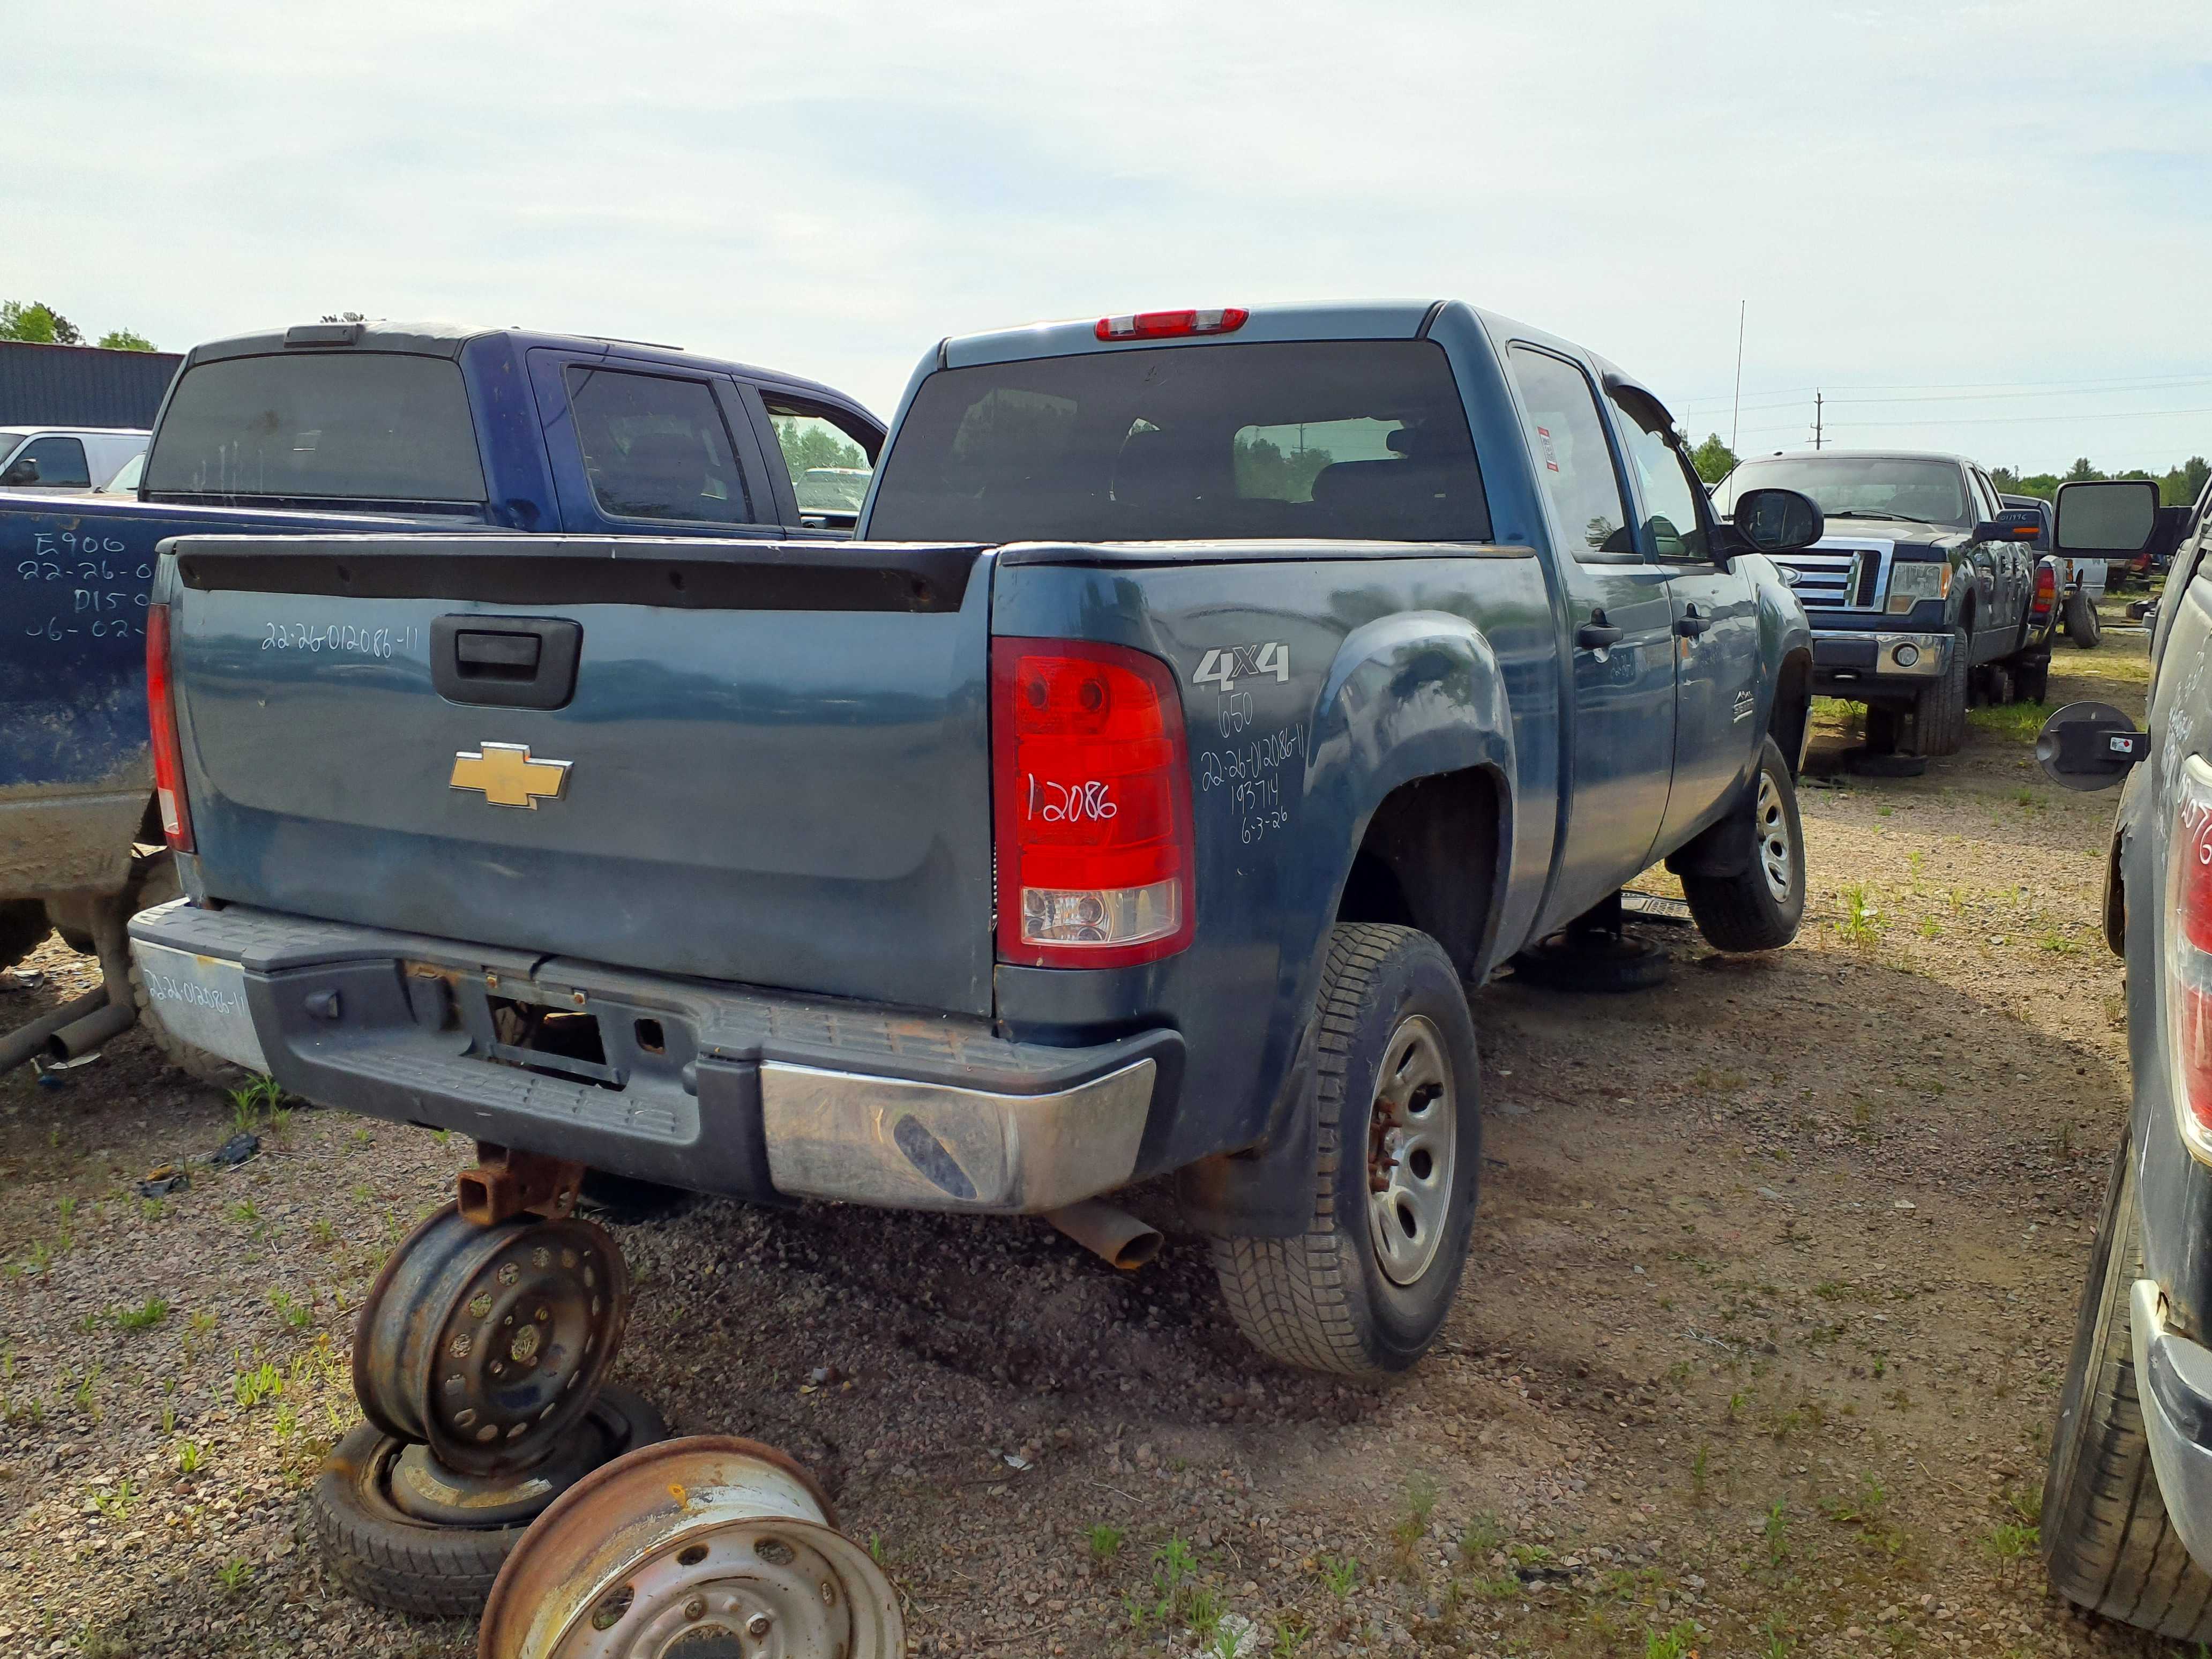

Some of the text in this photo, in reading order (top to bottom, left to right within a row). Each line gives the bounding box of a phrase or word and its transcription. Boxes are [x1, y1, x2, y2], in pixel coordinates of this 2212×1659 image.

[1218, 692, 1253, 738] 650
[1027, 773, 1117, 822] 12086
[1231, 772, 1278, 815] 193714
[1242, 805, 1287, 844] 6-3-26
